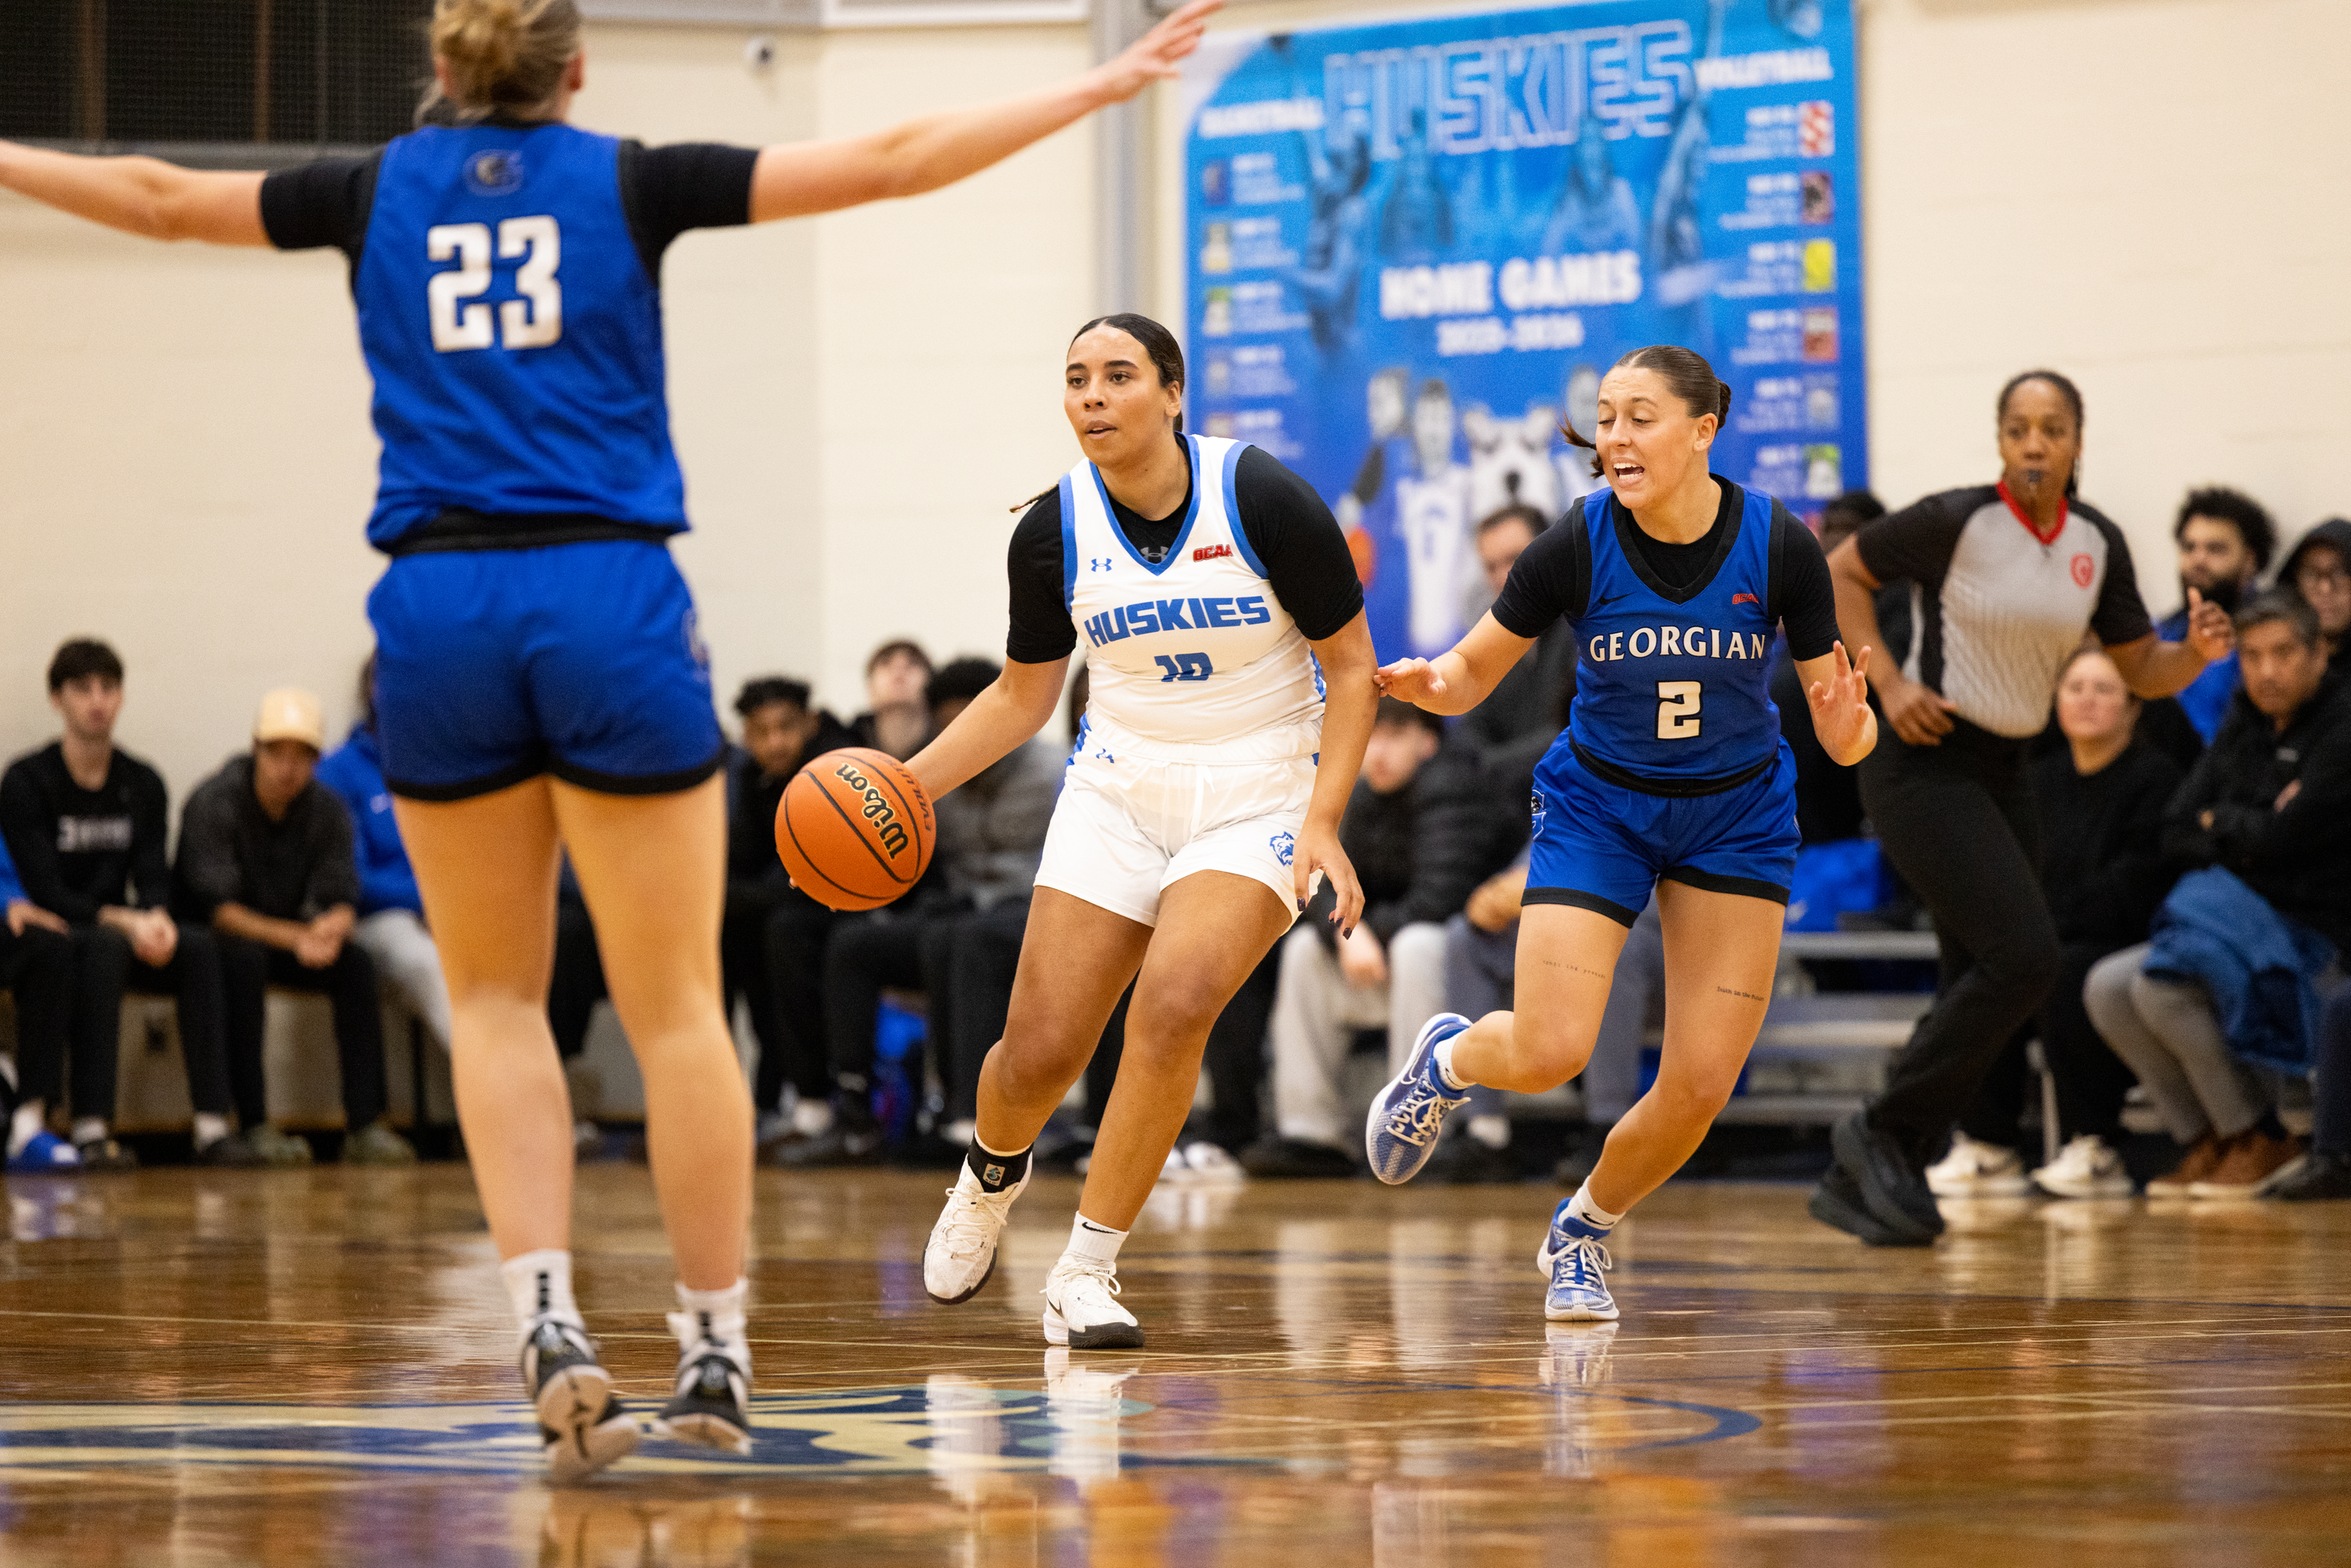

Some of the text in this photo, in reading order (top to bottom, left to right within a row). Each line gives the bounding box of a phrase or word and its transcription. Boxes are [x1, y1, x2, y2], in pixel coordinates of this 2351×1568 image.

[427, 215, 562, 353] 23
[1501, 250, 1641, 310] GAMES
[1084, 596, 1271, 648] HUSKIES
[1590, 626, 1766, 661] GEORGIAN
[1154, 652, 1213, 682] 10
[1657, 681, 1701, 740] 2
[834, 763, 910, 861] Wilson
[876, 753, 931, 832] EVOLUT
